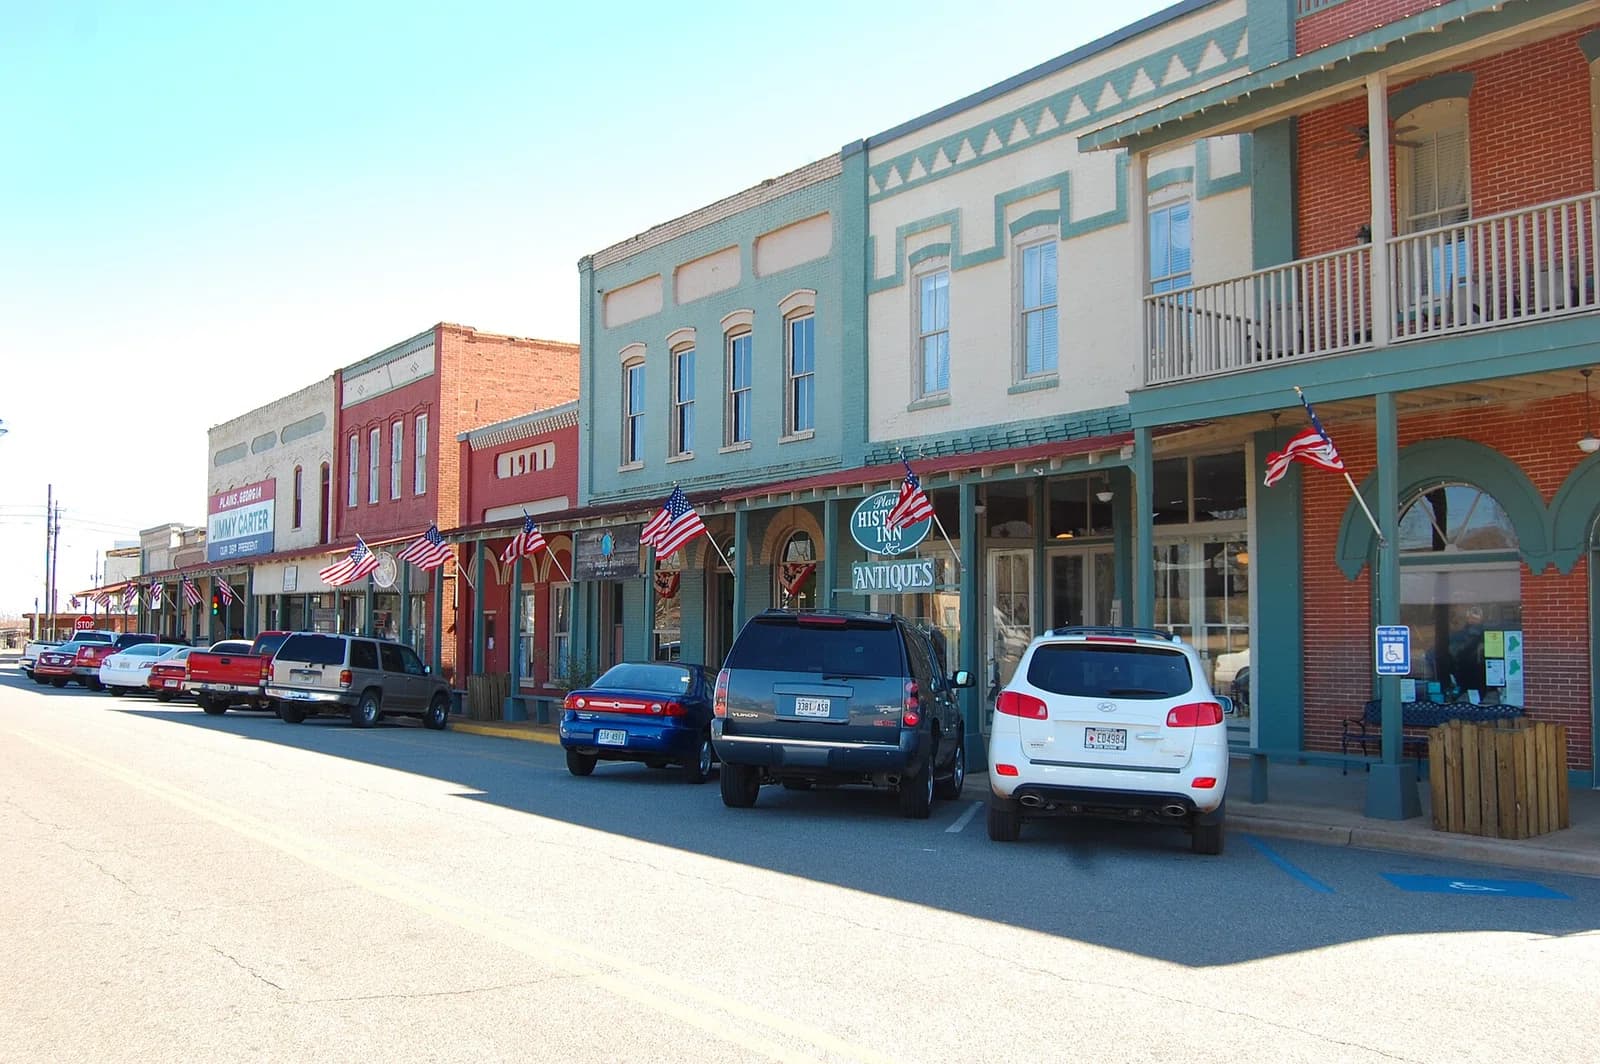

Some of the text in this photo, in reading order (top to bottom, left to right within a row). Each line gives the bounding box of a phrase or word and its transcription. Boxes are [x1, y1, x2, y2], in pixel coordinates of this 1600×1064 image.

[213, 509, 269, 540] JIMMY CARTER
[877, 527, 902, 543] INN
[881, 543, 900, 555] &
[855, 563, 932, 592] ANTIQUES
[77, 621, 95, 629] STOP
